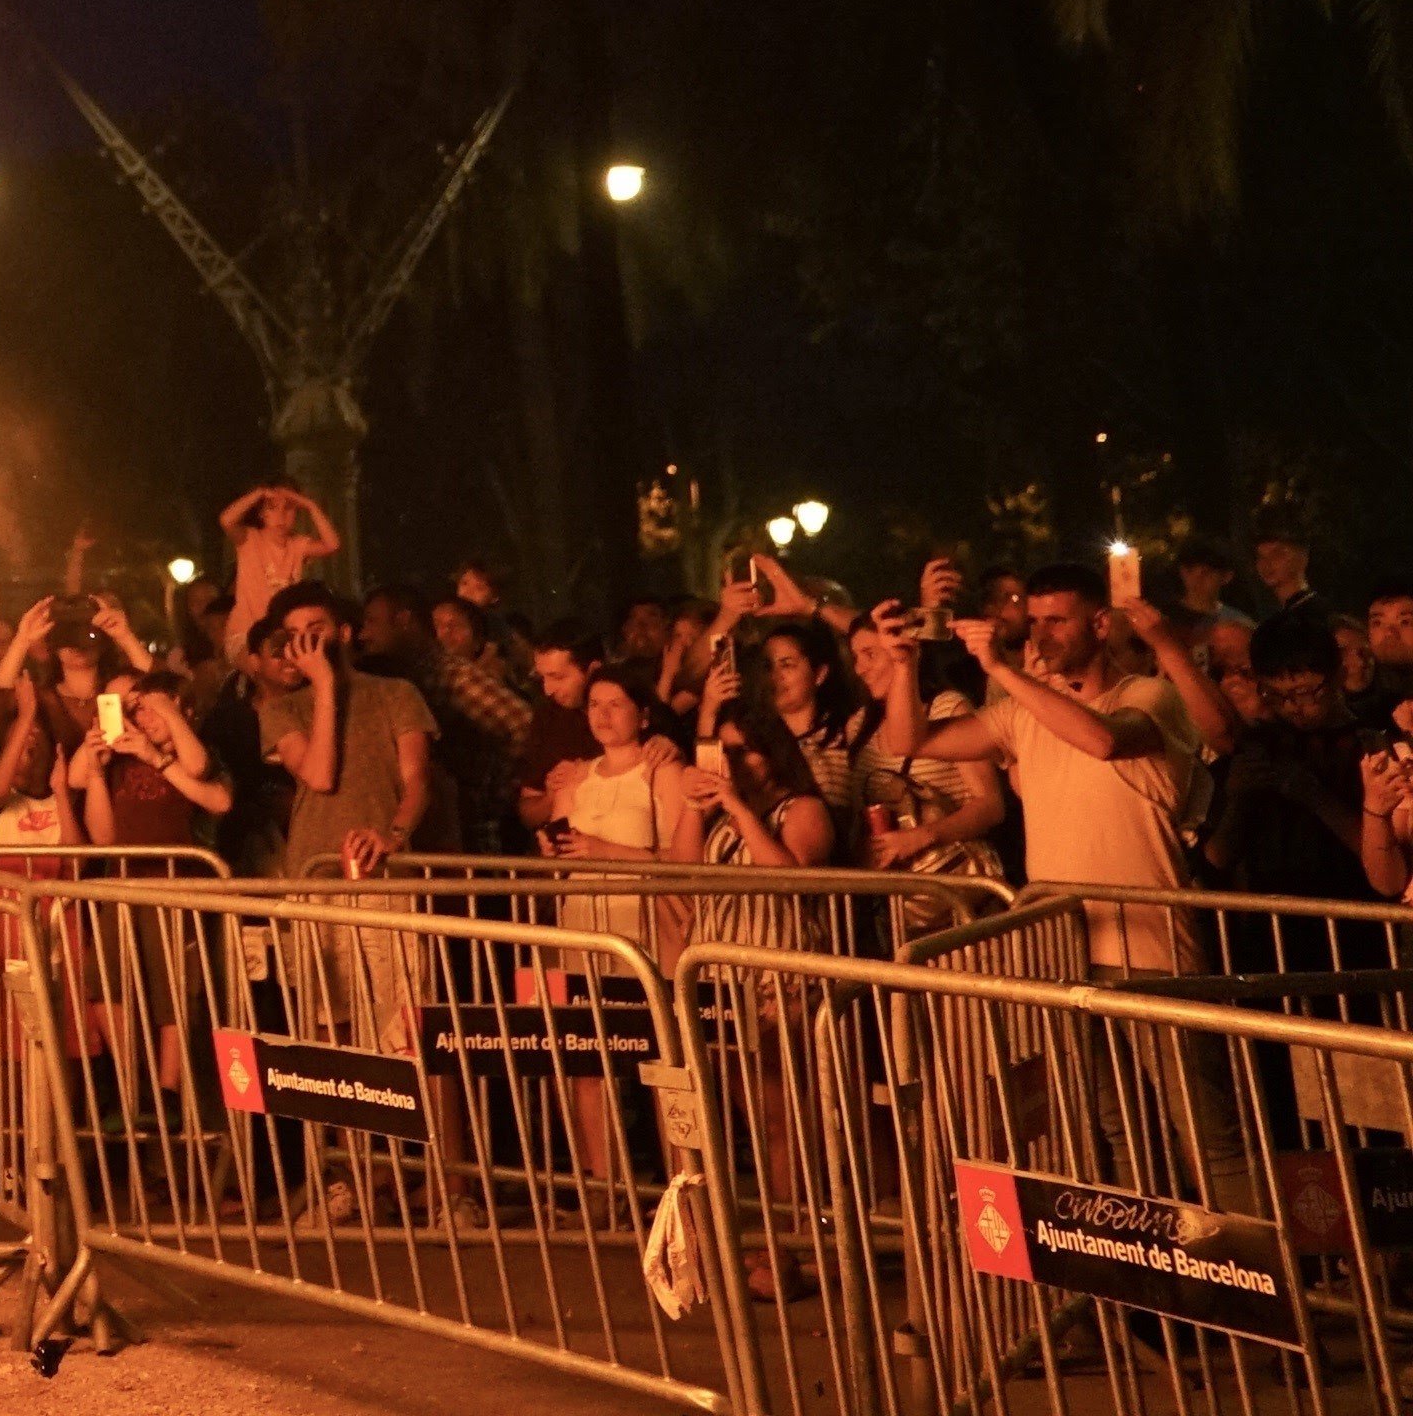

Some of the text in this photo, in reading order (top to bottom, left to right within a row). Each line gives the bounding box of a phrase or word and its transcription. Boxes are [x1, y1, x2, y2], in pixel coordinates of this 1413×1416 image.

[267, 1068, 416, 1111] Ajuntament de Barcelona
[1037, 1219, 1278, 1297] Ajuntament de Barcelona
